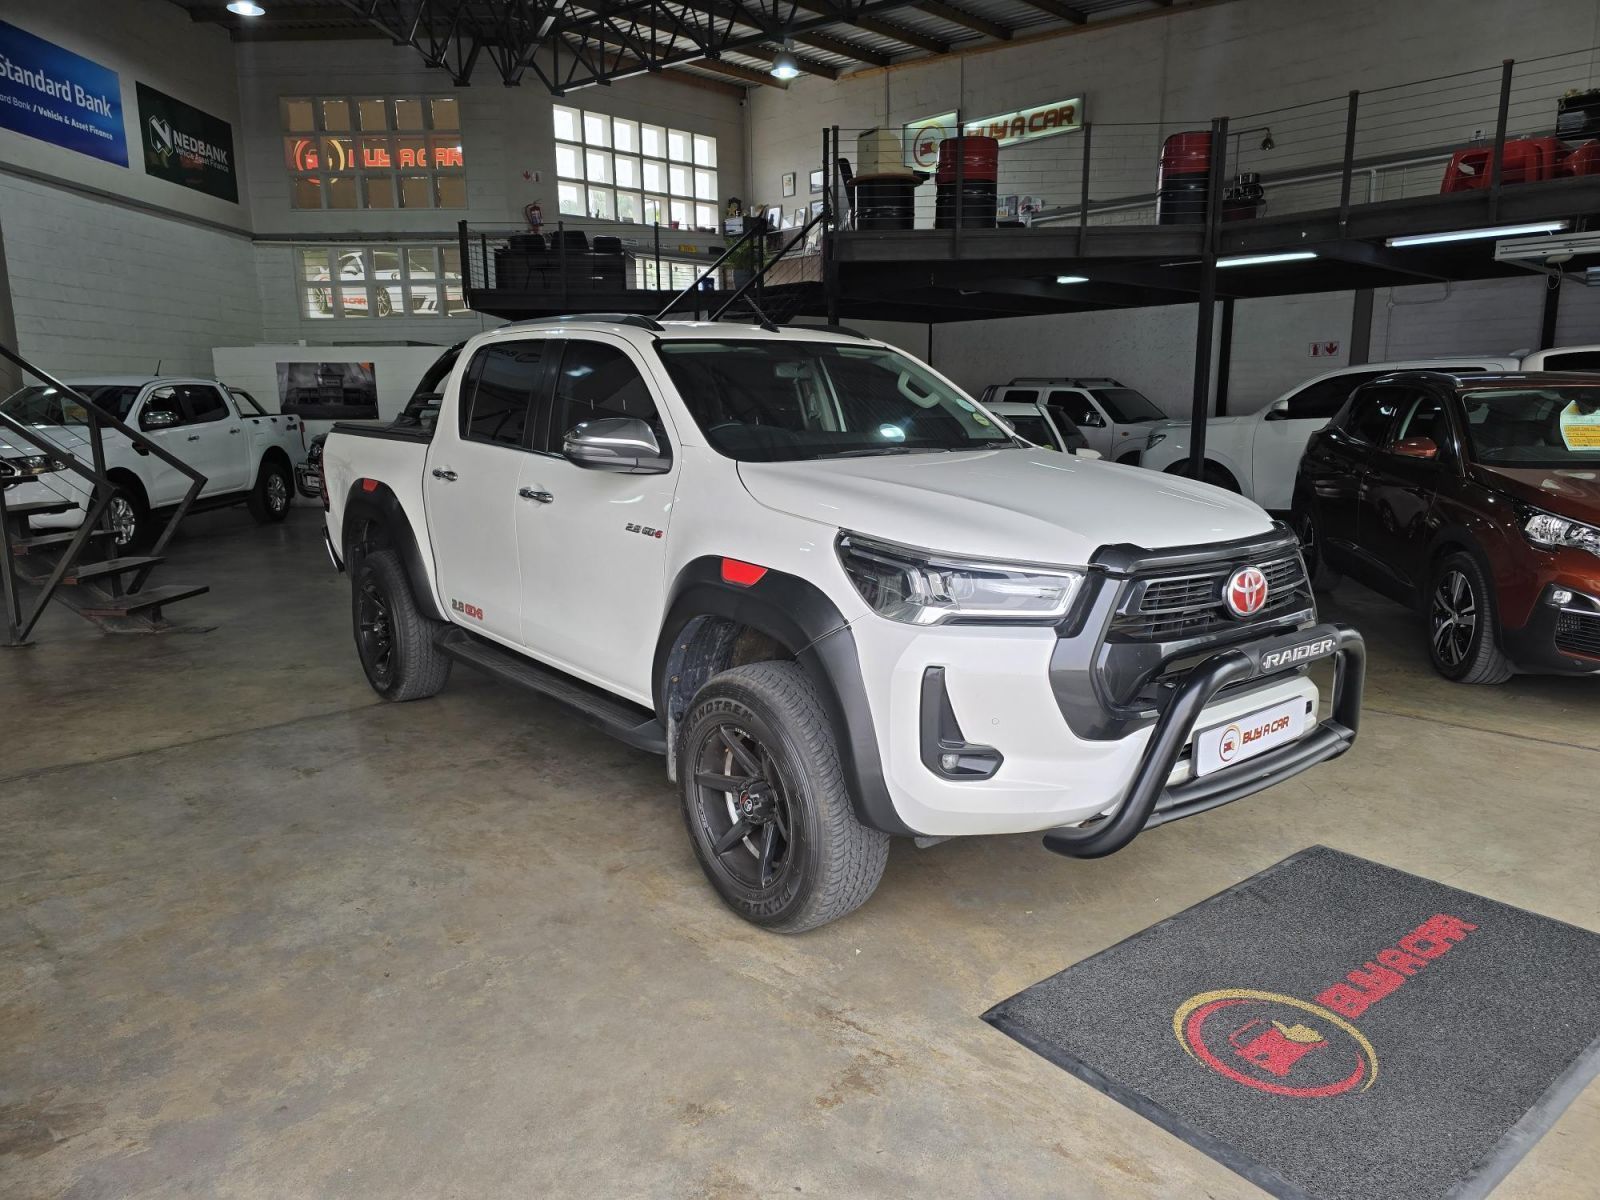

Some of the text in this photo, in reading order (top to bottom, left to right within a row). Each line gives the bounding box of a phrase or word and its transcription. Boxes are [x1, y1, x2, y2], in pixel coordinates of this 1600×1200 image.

[0, 54, 113, 119] Standard Bank
[38, 106, 63, 123] Vehicle
[71, 118, 89, 132] Asset
[89, 124, 113, 141] Finance
[1010, 116, 1026, 137] A
[1029, 104, 1075, 132] CAR
[172, 129, 229, 165] NEDBANK
[1264, 639, 1334, 669] RAIDER
[1242, 715, 1290, 745] BUY A CAR
